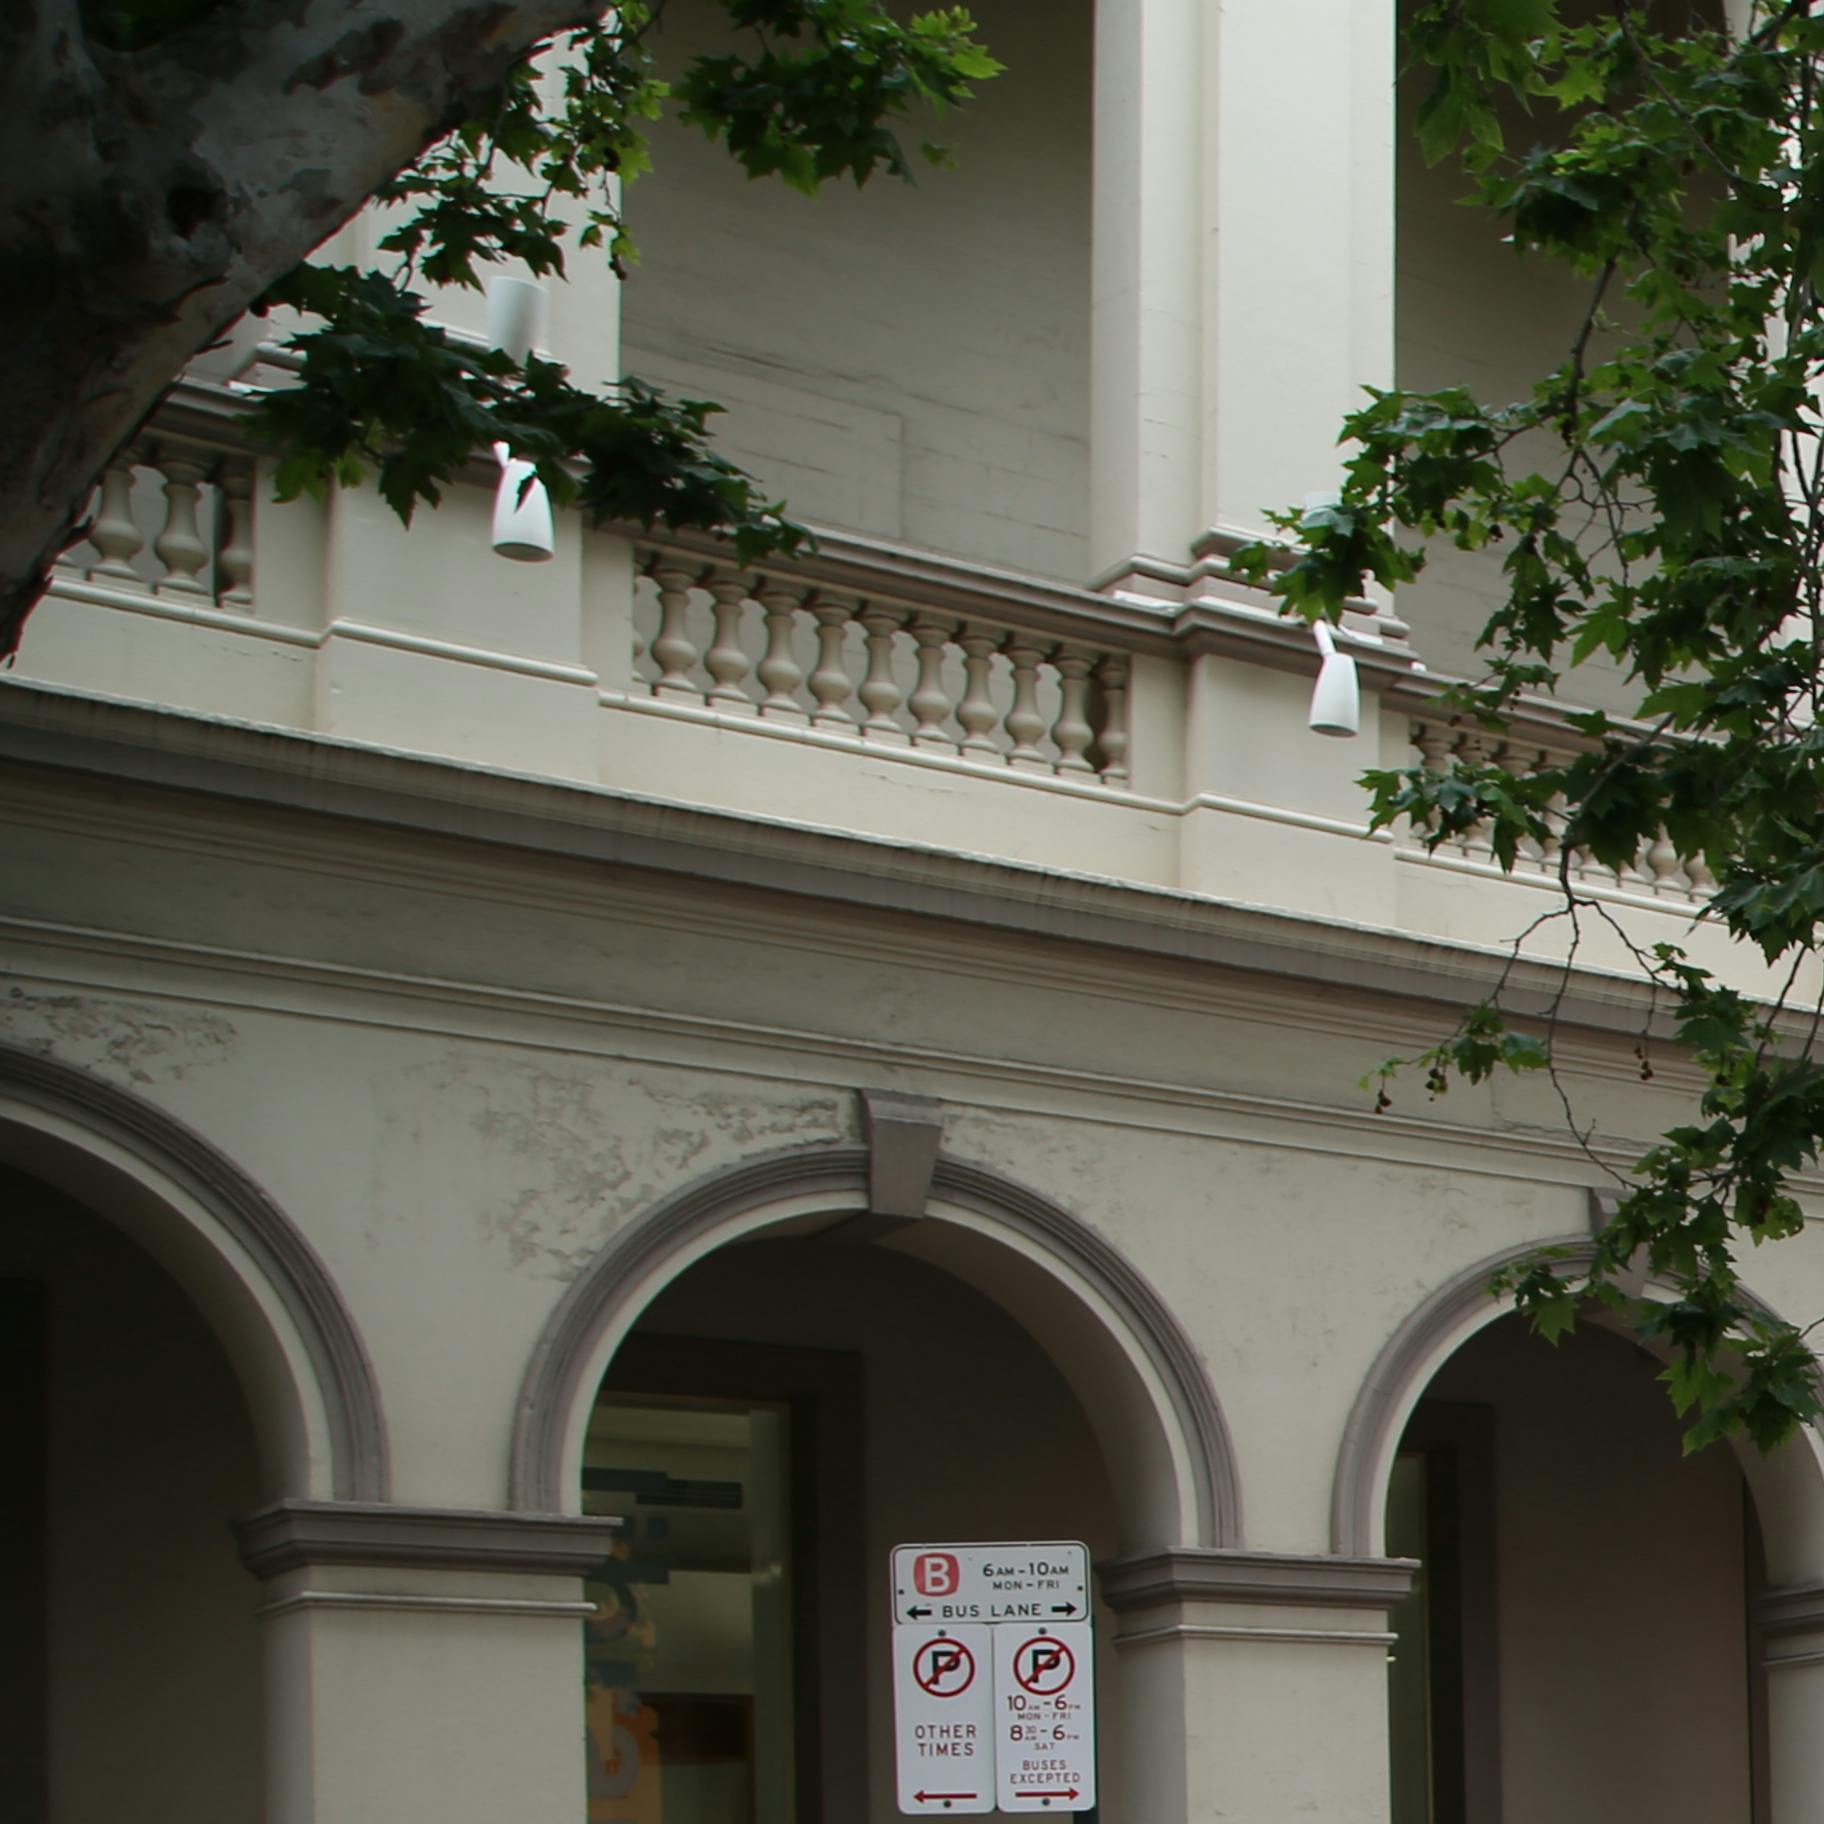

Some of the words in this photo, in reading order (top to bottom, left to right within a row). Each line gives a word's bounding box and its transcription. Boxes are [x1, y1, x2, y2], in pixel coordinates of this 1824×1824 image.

[942, 1604, 980, 1618] BUS
[991, 1603, 1042, 1617] LANE
[915, 1724, 977, 1740] OTHER
[917, 1743, 975, 1757] TIMES
[1034, 1743, 1055, 1751] SAT
[1022, 1759, 1067, 1771] BUSES
[1009, 1772, 1081, 1785] EXCEPTED
